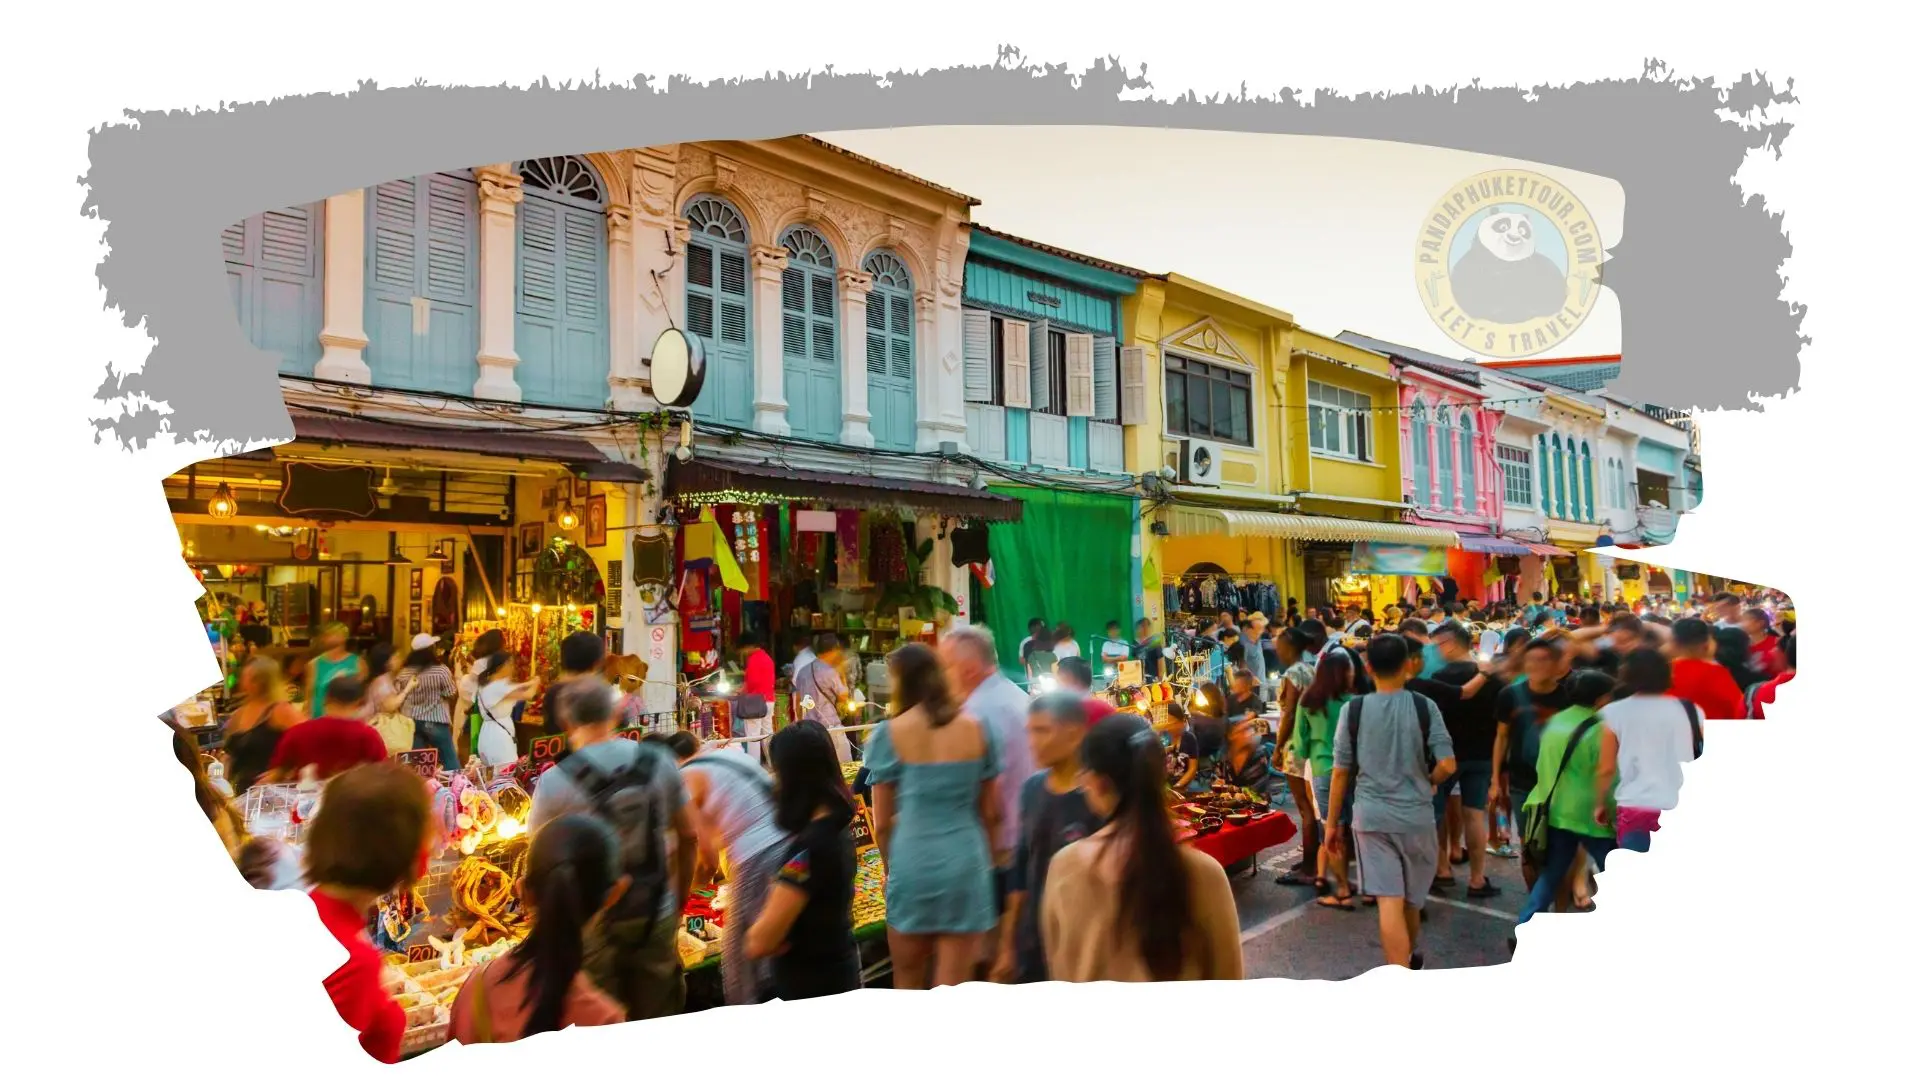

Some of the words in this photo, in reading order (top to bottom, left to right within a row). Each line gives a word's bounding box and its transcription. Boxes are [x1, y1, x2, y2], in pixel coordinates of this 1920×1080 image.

[534, 736, 561, 758] 50
[688, 917, 703, 930] 10
[411, 947, 431, 962] 20
